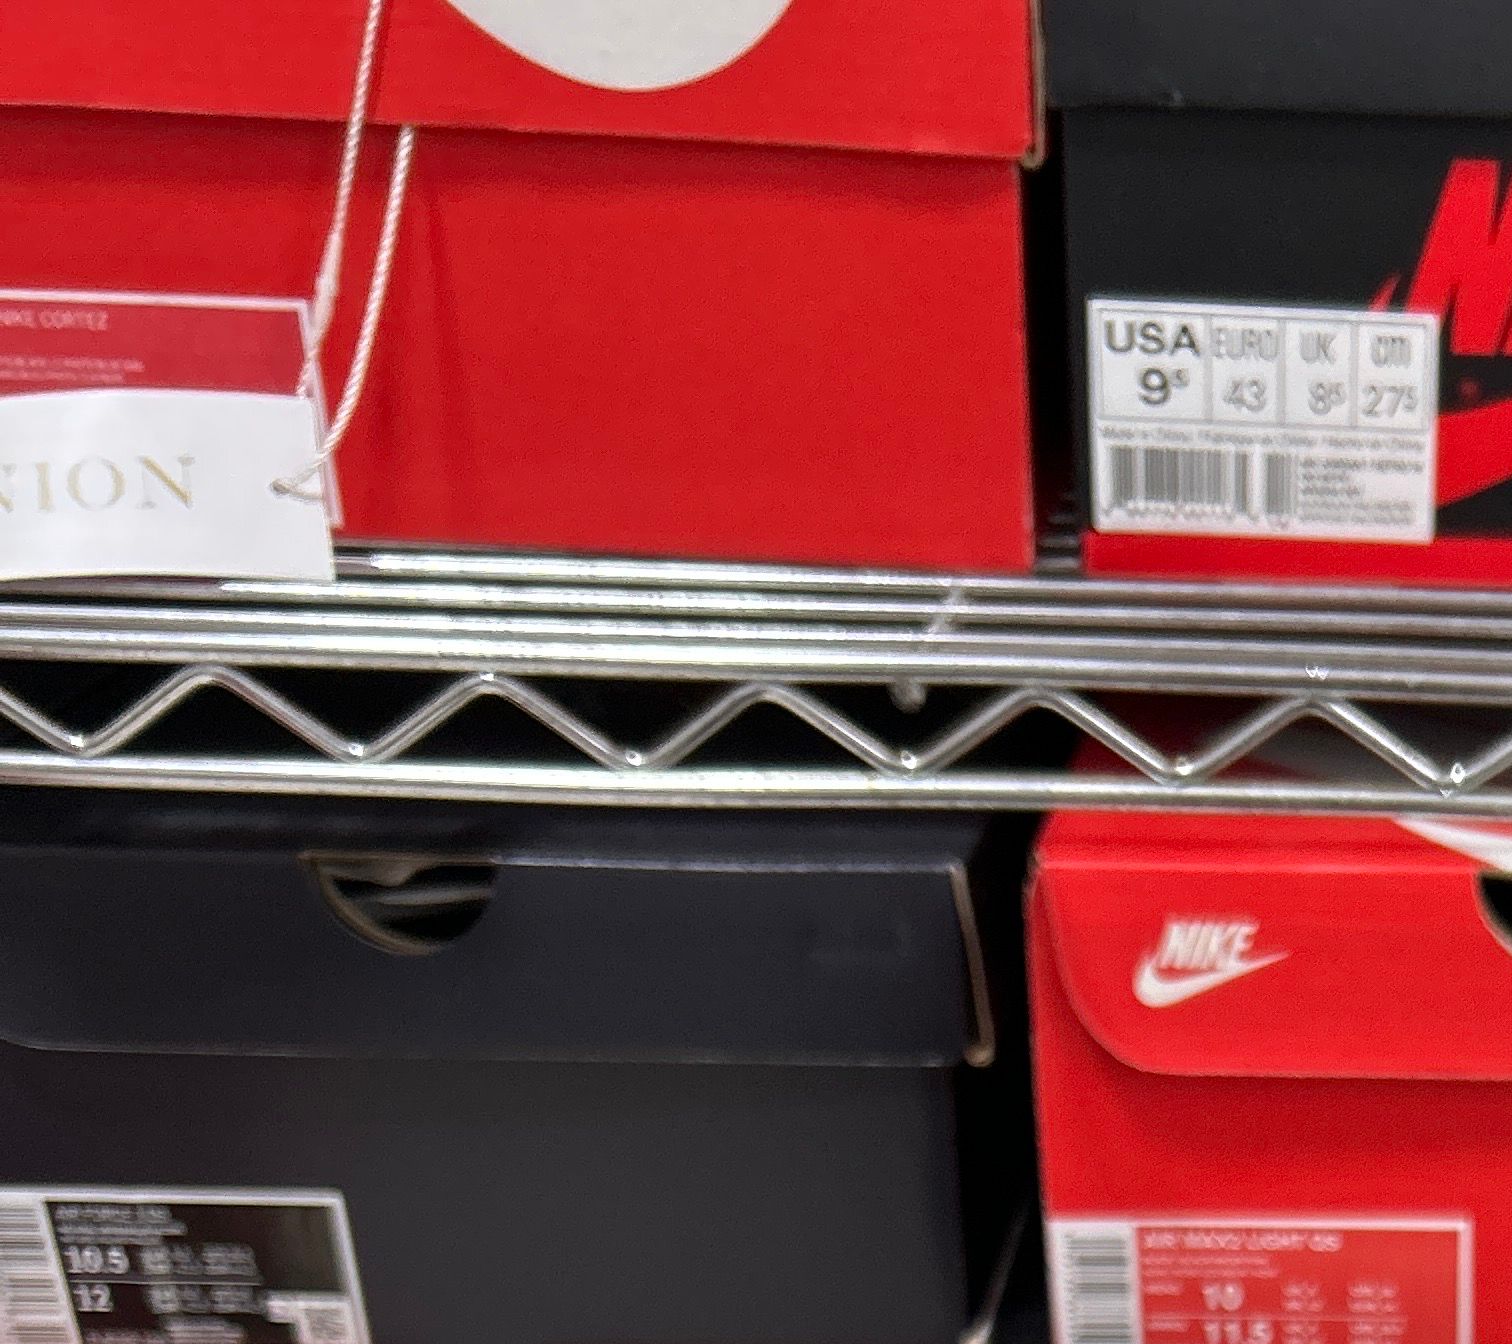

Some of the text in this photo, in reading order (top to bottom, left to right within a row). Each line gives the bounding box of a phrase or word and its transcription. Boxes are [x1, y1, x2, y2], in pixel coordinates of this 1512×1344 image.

[1104, 319, 1199, 355] USA
[1212, 326, 1280, 361] EURO
[1300, 331, 1337, 364] UK
[1223, 378, 1266, 413] 43
[1156, 921, 1260, 970] NIKE
[72, 1283, 114, 1313] 12
